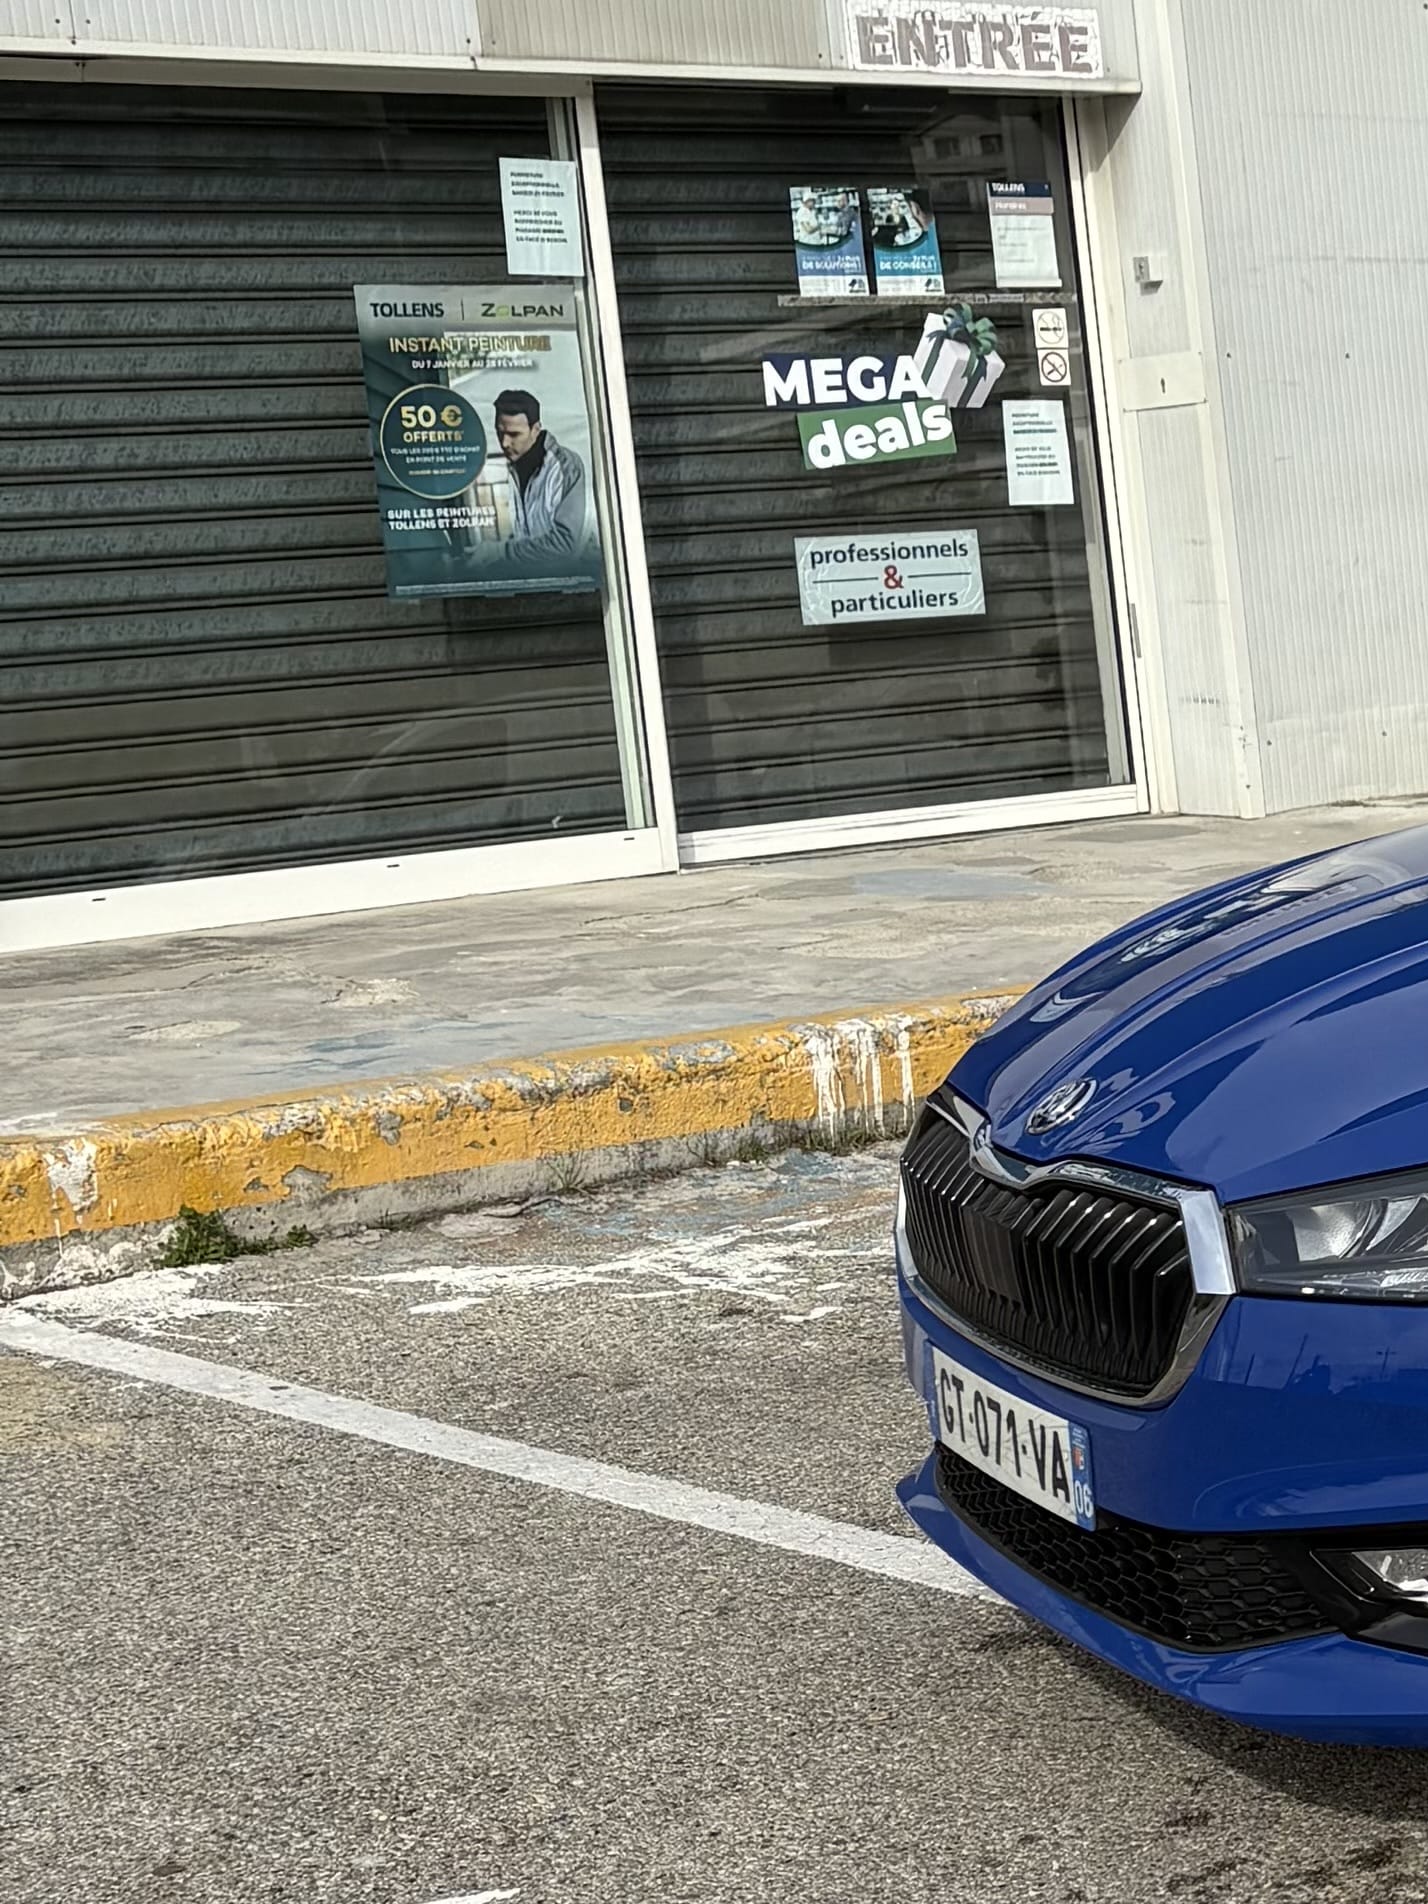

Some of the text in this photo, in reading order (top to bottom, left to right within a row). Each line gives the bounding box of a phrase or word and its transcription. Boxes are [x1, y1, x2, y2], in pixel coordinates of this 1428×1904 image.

[370, 302, 564, 318] TOLLENS ZOLPAN
[389, 335, 552, 353] INSTANT PEINTURE
[762, 355, 938, 406] MEGA
[401, 405, 463, 428] 50 €
[807, 401, 953, 469] deals
[387, 509, 411, 520] SUR
[413, 508, 434, 519] LES
[810, 539, 969, 568] professionnels
[883, 565, 904, 589] &
[831, 590, 959, 618] particuliers
[1074, 1480, 1094, 1518] 06
